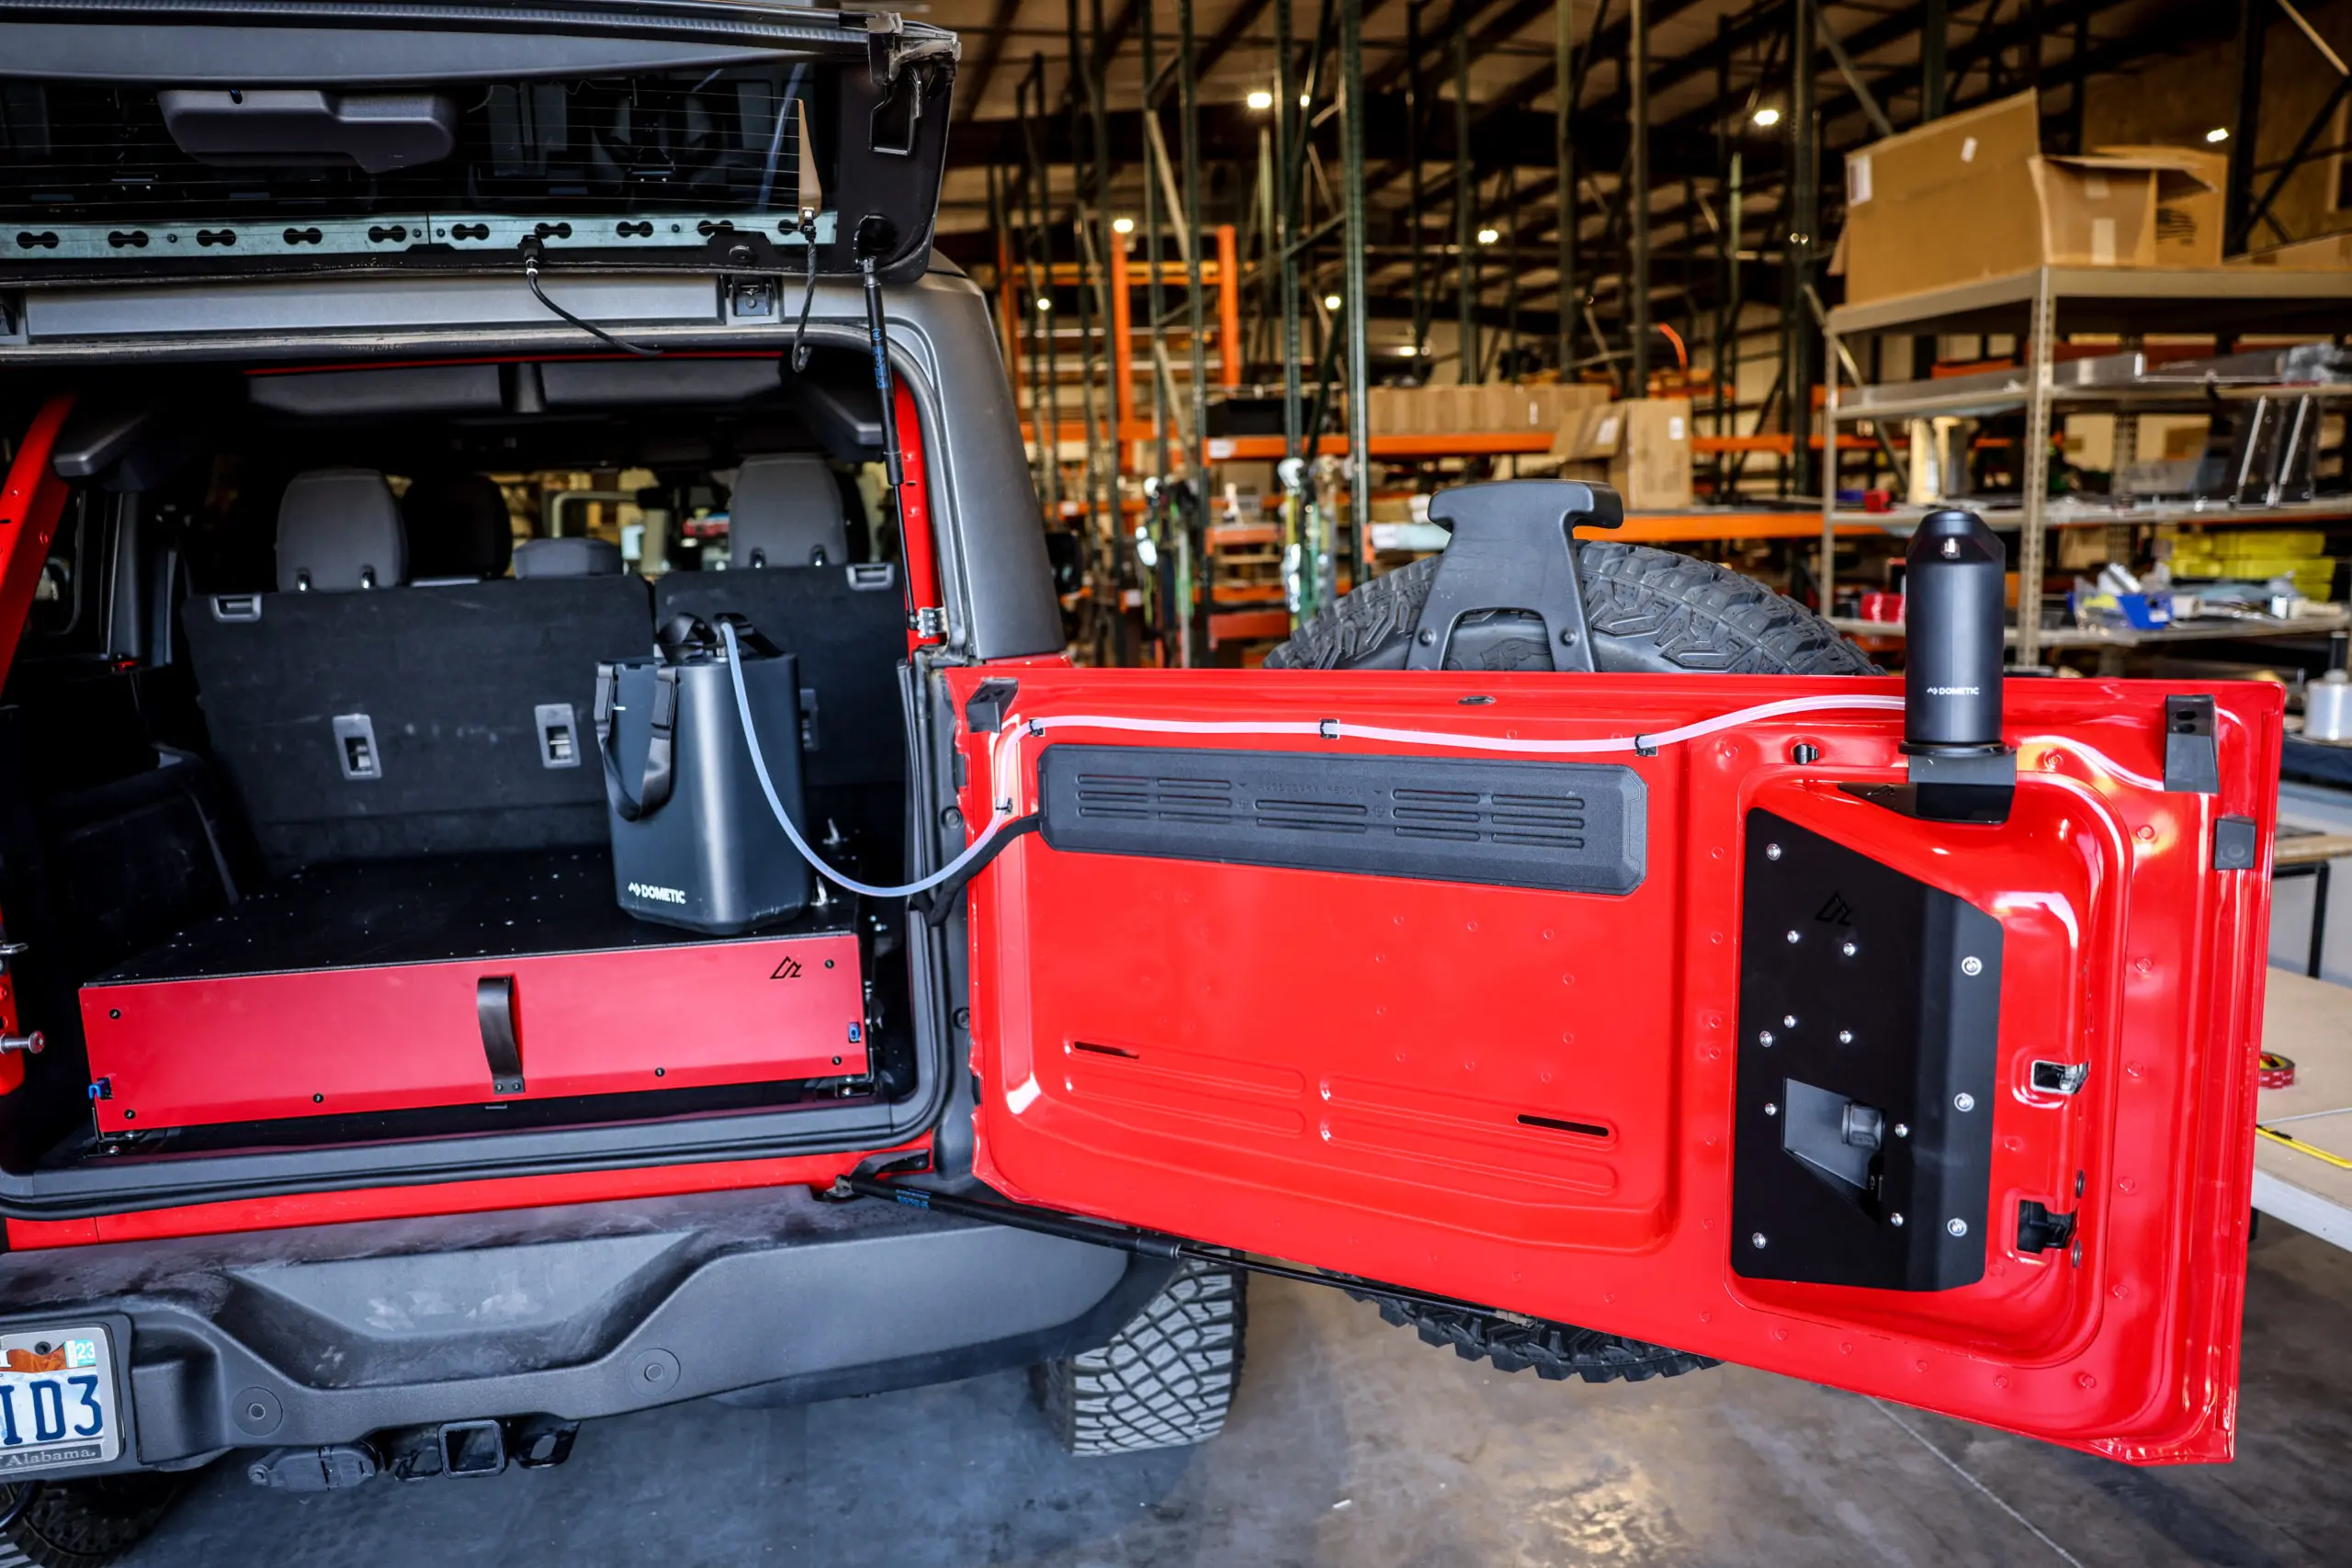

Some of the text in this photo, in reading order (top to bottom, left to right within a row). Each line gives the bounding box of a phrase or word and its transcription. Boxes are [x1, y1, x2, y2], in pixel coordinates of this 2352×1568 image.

[1939, 686, 1980, 695] DOMETIC
[640, 884, 686, 905] DOMETIC
[76, 1342, 96, 1359] 23
